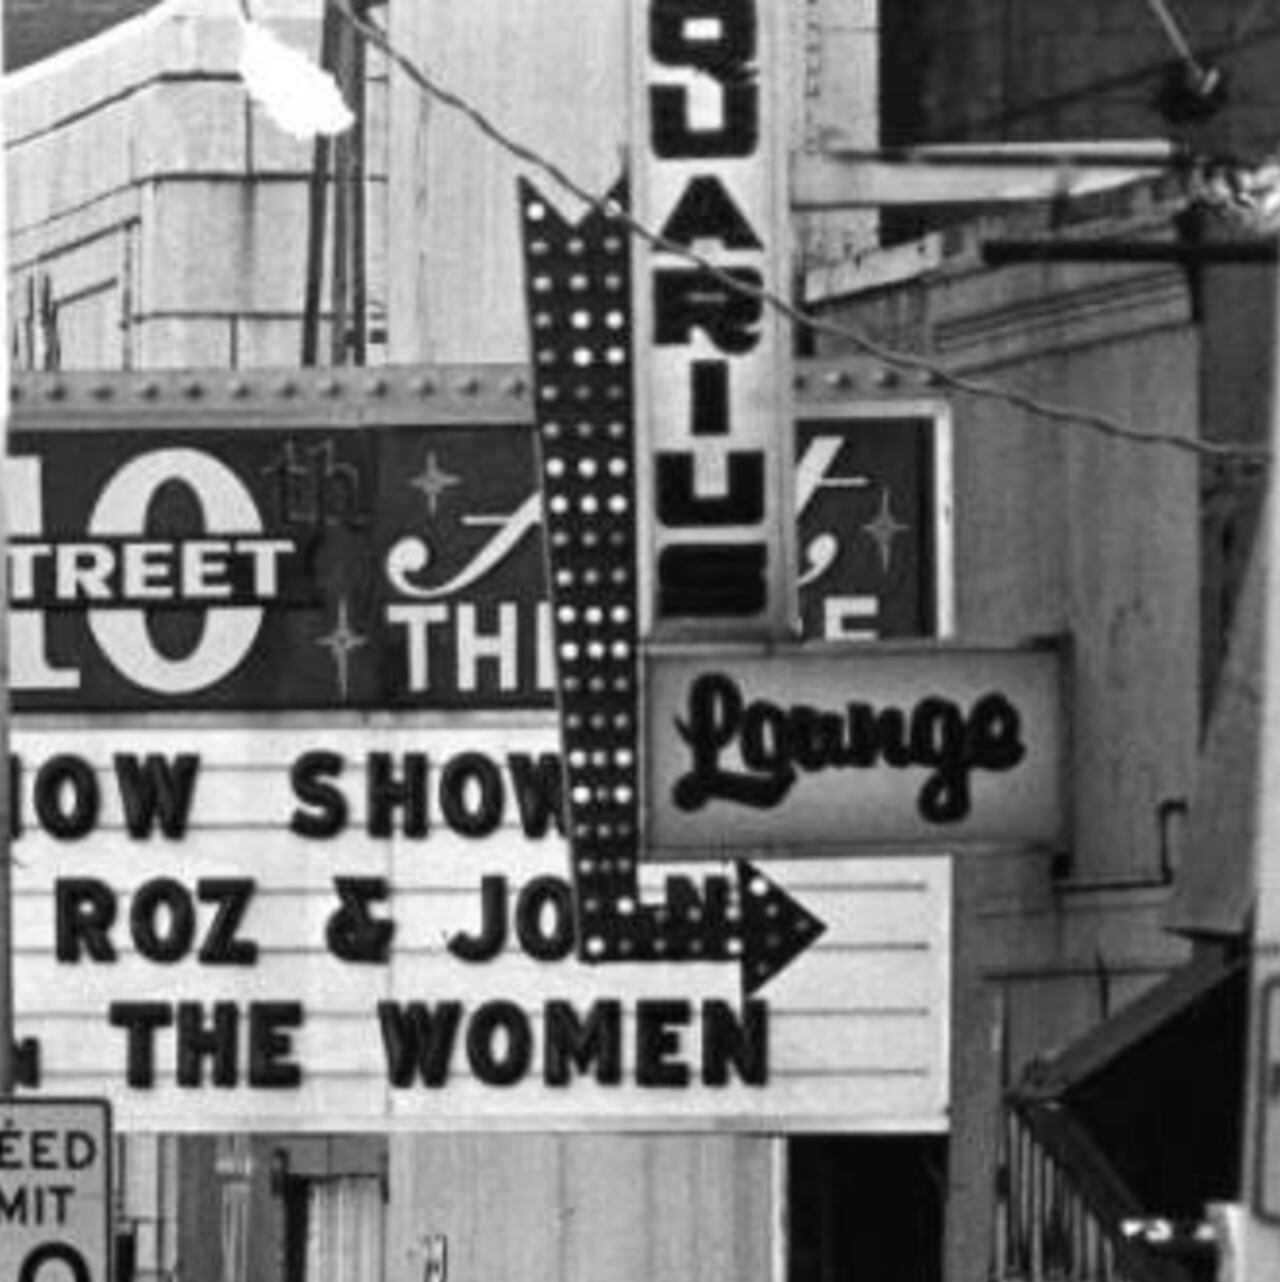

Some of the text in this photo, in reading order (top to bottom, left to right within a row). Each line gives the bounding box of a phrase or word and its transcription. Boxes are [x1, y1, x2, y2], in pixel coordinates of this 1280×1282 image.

[670, 672, 1026, 825] Lounge
[287, 751, 567, 841] SHOW
[54, 876, 260, 966] ROZ
[325, 875, 397, 963] &
[109, 1001, 304, 1089] THE
[377, 999, 770, 1089] WOMEN
